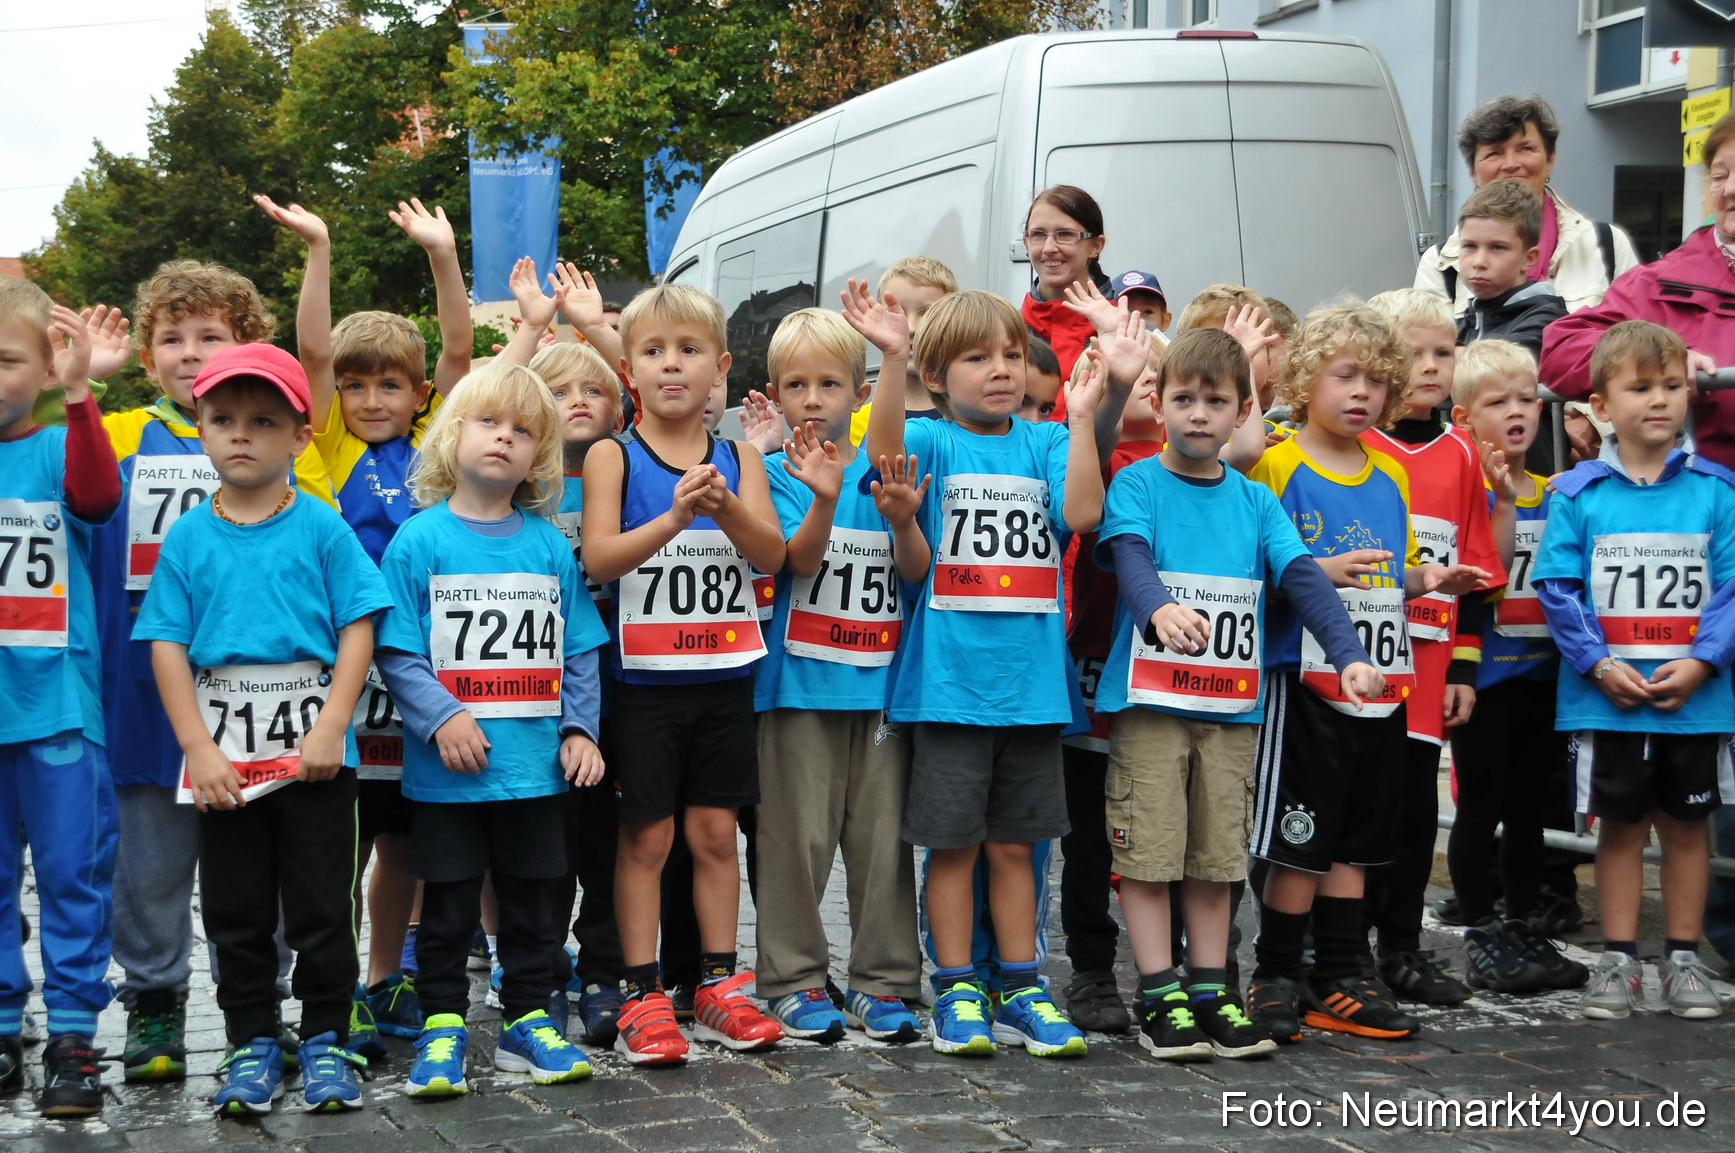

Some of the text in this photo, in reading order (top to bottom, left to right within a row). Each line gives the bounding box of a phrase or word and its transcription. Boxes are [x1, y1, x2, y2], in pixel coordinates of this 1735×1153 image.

[473, 167, 516, 176] Neumarkt
[137, 469, 187, 480] PARTL
[943, 488, 1039, 504] PARTL Neumarkt
[950, 508, 1051, 560] 7583
[676, 544, 733, 557] Neumarkt
[1596, 546, 1695, 558] PARTL Neumarkt
[948, 567, 983, 586] Pelle
[435, 588, 547, 602] PARTL Neumarkt
[637, 564, 746, 615] 7082
[809, 559, 898, 614] 7159
[1603, 564, 1703, 610] 7125
[1195, 588, 1251, 605] Neumarkt
[446, 608, 557, 661] 7244
[673, 629, 718, 650] Joris
[1633, 623, 1672, 640] Luis
[198, 675, 313, 693] PARTL Neumarkt
[456, 675, 553, 697] Maximilian
[1171, 669, 1234, 693] Marlon
[209, 695, 326, 753] 7140
[327, 1046, 347, 1056] FILA
